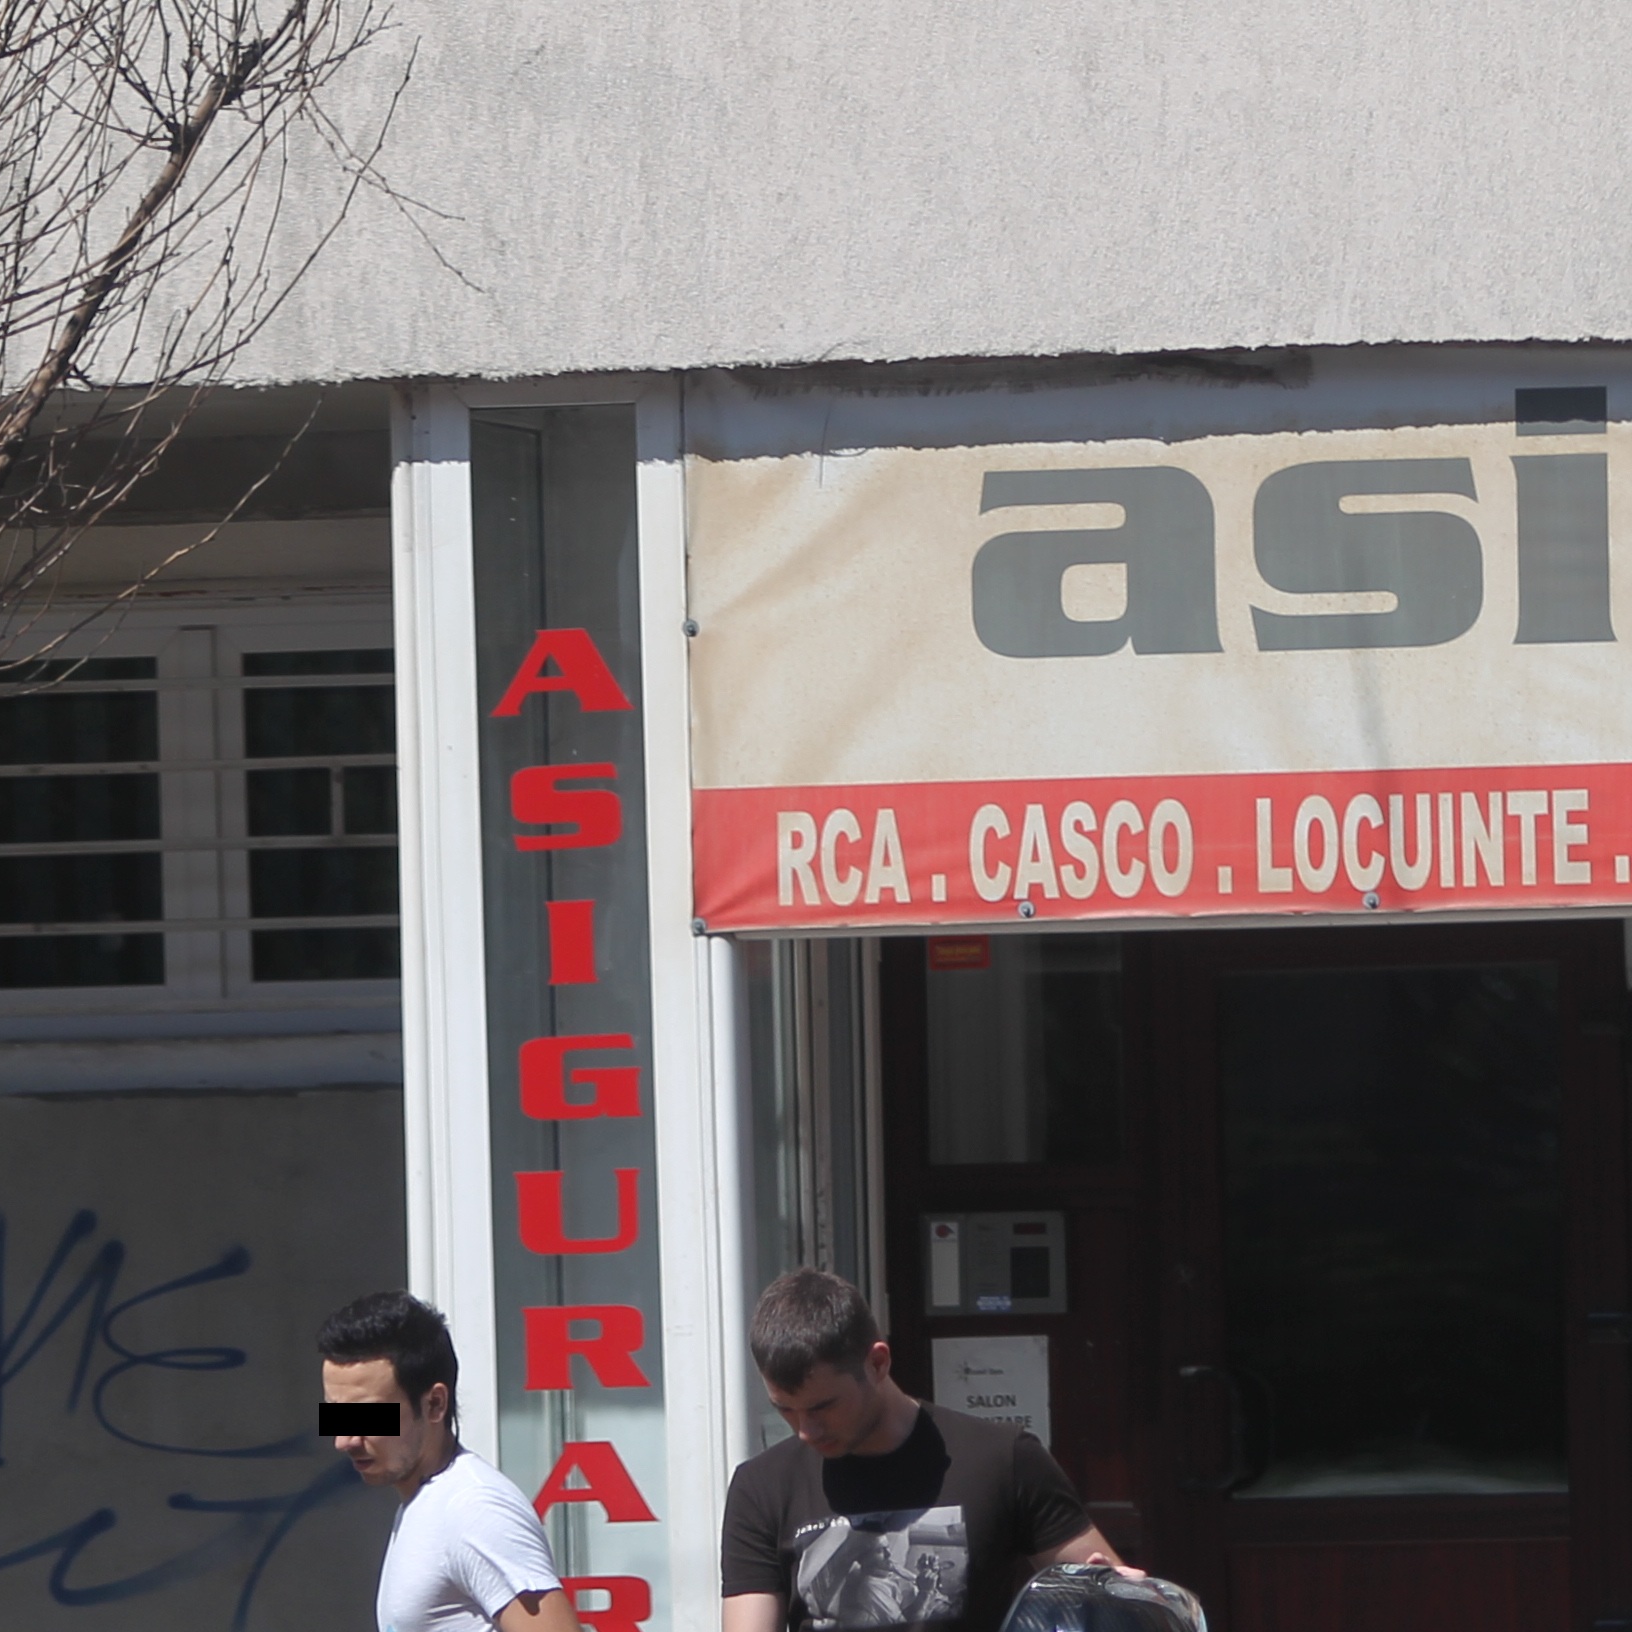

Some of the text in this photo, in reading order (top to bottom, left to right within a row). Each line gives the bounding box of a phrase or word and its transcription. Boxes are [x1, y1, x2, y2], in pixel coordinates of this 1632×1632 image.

[777, 809, 911, 908] RCA
[970, 798, 1194, 899] CASCO
[1256, 789, 1590, 895] LOCUINTE
[966, 1394, 1017, 1408] SALON
